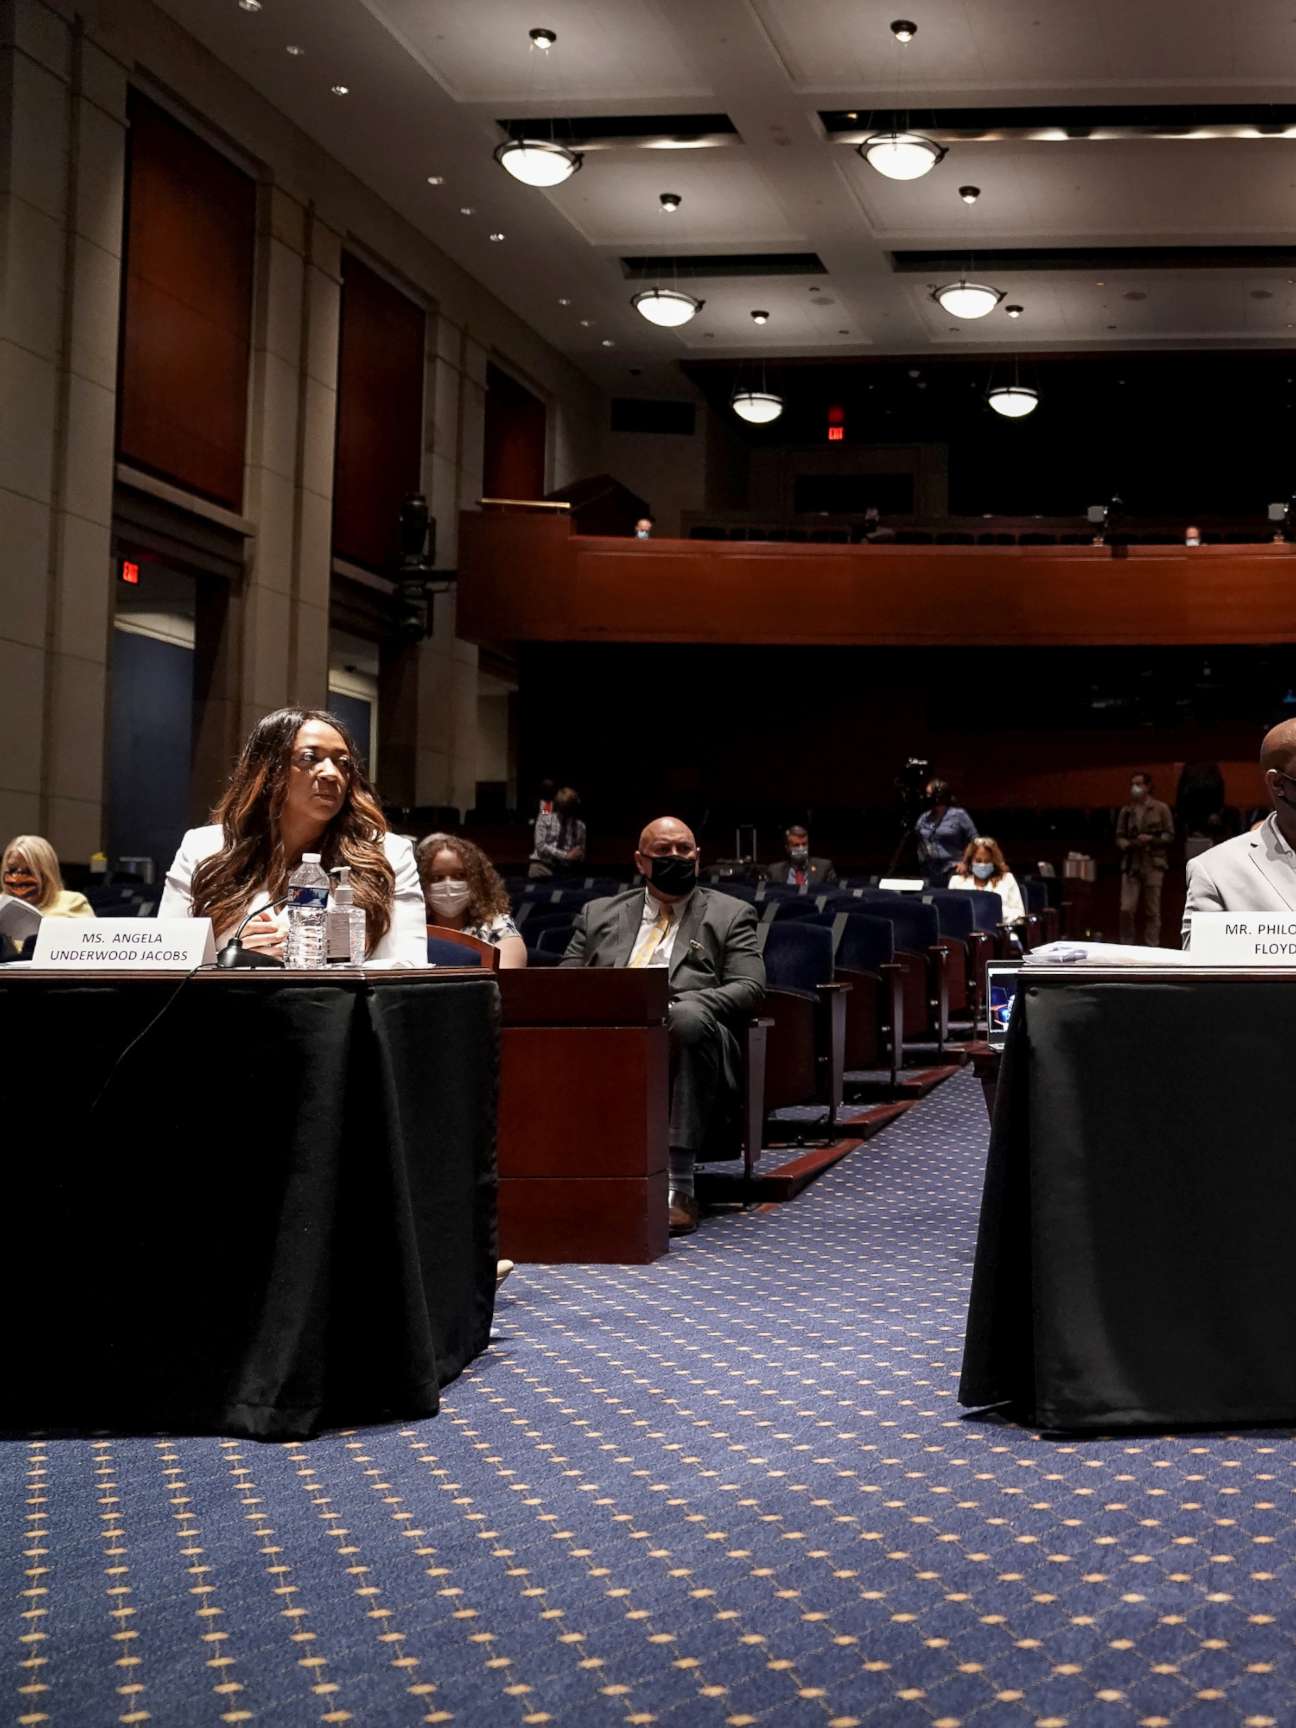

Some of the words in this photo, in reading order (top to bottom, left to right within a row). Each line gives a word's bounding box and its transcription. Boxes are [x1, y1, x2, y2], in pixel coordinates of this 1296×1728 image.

[1225, 924, 1252, 935] MR.
[82, 933, 105, 944] MS.
[112, 933, 163, 944] ANGELA
[50, 950, 137, 961] UNDERWOOD
[140, 950, 188, 961] JACOBS
